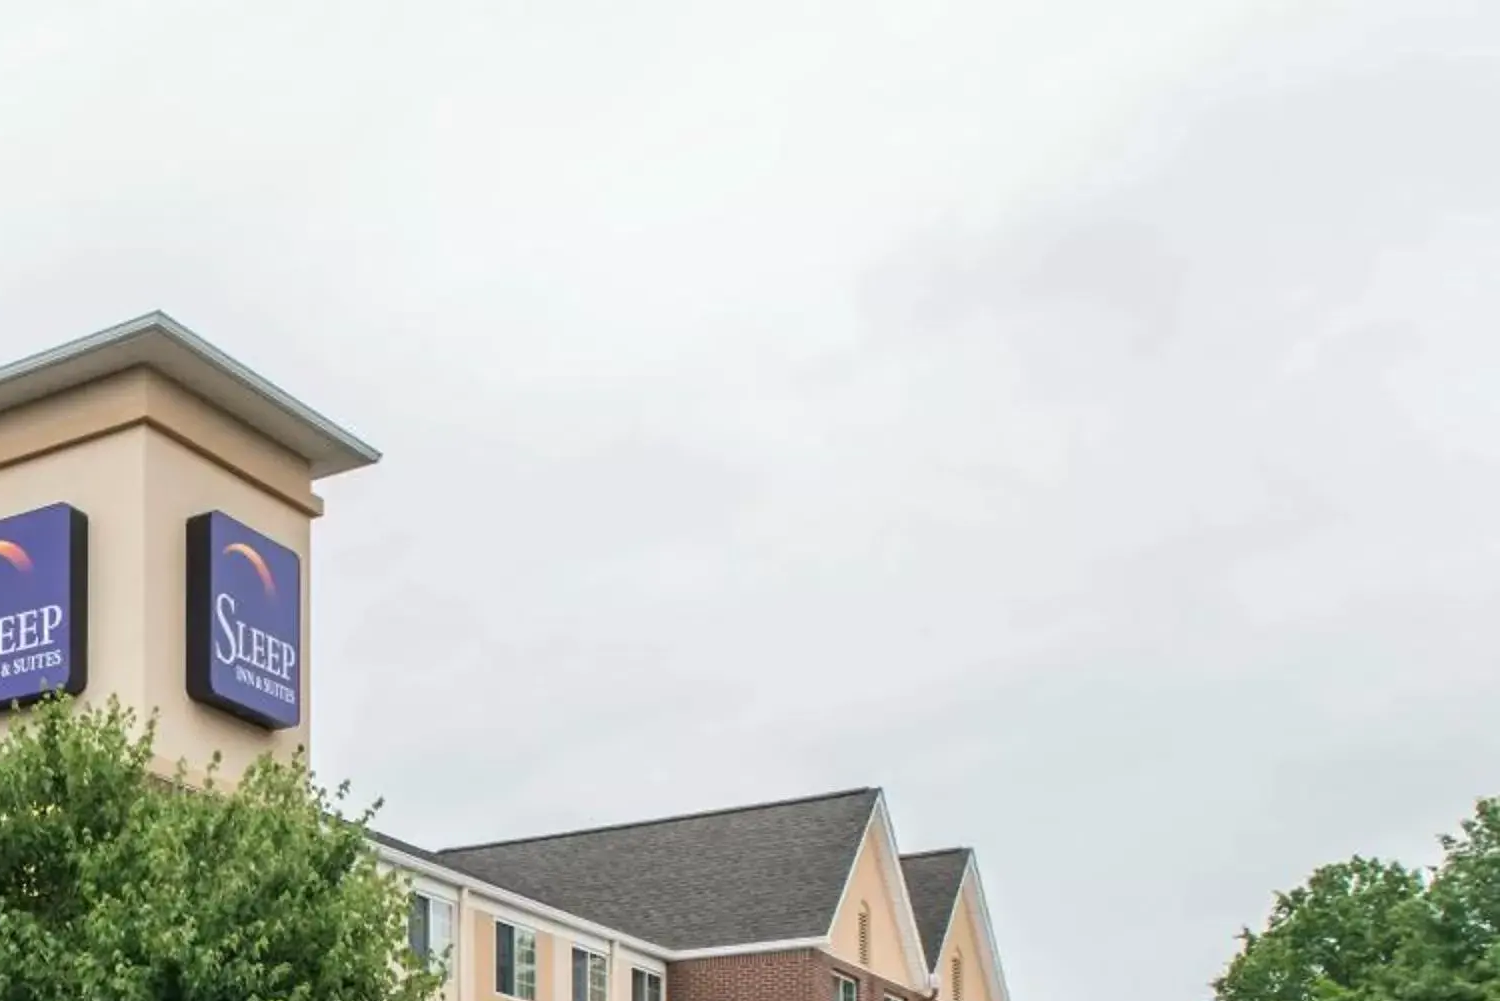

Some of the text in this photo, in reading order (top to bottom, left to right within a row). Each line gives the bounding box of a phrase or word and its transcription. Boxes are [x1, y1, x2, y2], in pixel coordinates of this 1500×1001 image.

[215, 593, 296, 681] SLEEP
[0, 661, 12, 679] &
[13, 648, 62, 675] SUITES
[236, 664, 256, 687] INN
[263, 677, 295, 704] SUITES
